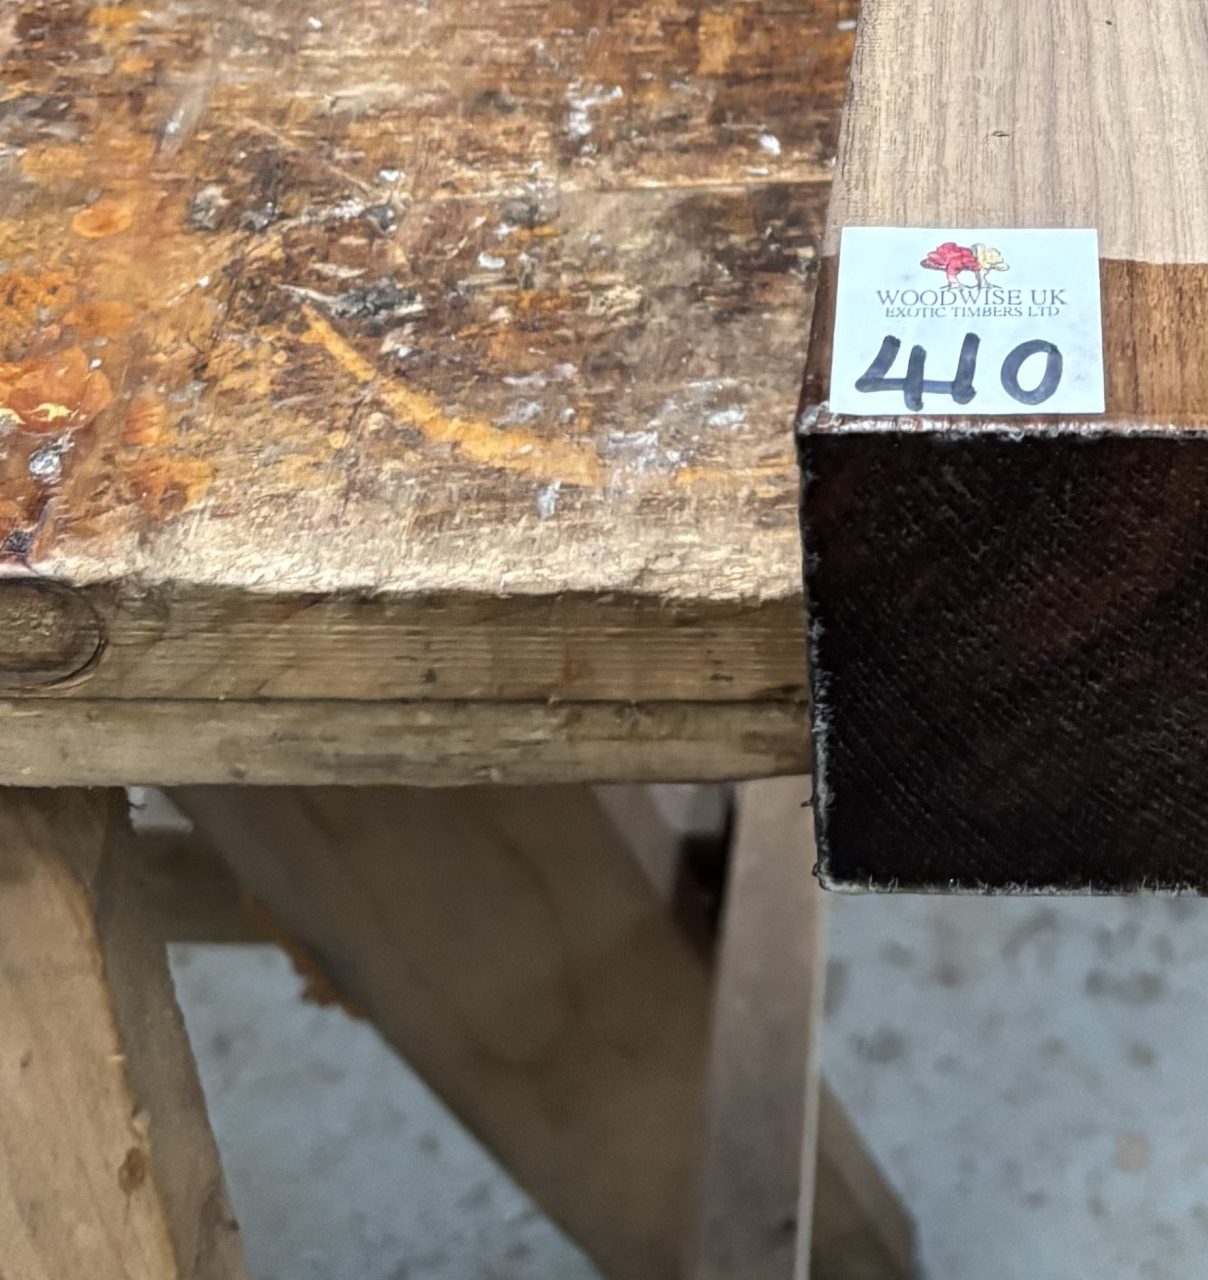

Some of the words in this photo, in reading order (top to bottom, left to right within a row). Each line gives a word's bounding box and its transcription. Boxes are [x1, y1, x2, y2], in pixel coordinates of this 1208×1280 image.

[876, 289, 1023, 306] WOODWISE
[1031, 289, 1069, 306] UK
[885, 307, 947, 318] EXOTIC
[950, 306, 1023, 318] TIMBERS
[1028, 306, 1060, 317] LTD
[854, 332, 1064, 412] 410
